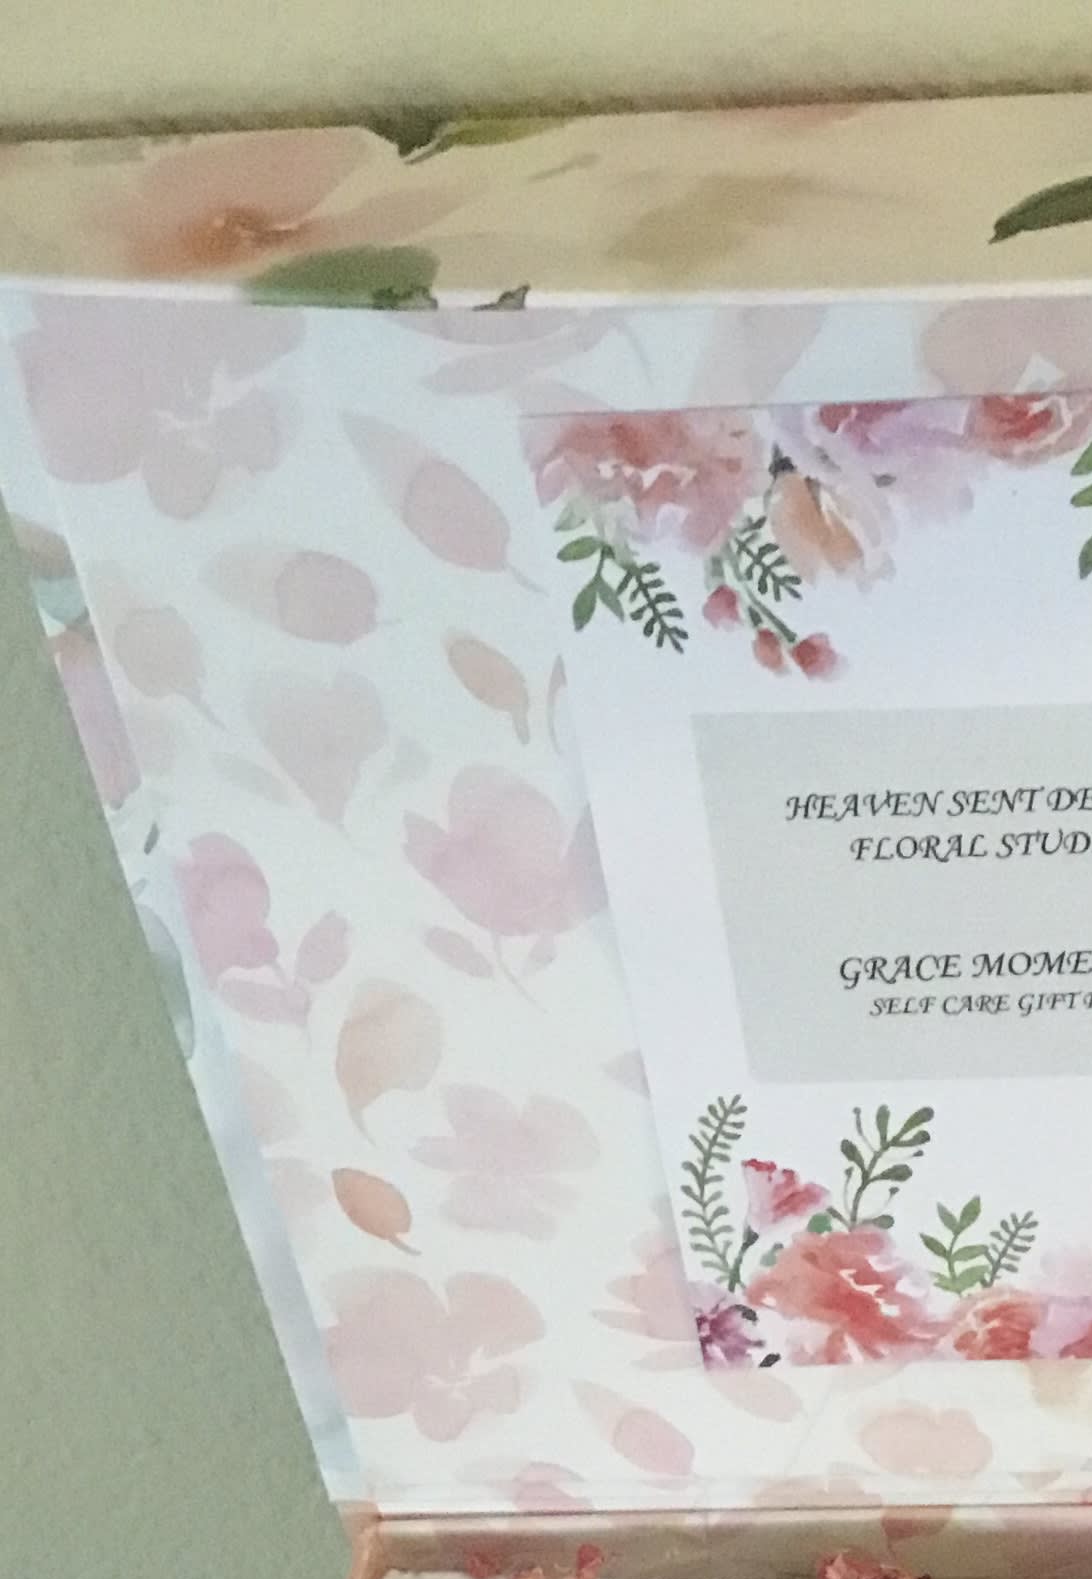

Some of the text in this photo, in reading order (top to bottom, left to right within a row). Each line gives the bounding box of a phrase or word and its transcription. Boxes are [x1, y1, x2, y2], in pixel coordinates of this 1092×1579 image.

[785, 789, 944, 821] HEAVEN
[947, 787, 1043, 817] SENT
[850, 832, 988, 862] FLORAL
[839, 952, 963, 990] GRACE
[869, 995, 936, 1017] SELF
[941, 994, 1011, 1016] CARE
[1017, 991, 1081, 1017] GIFT
